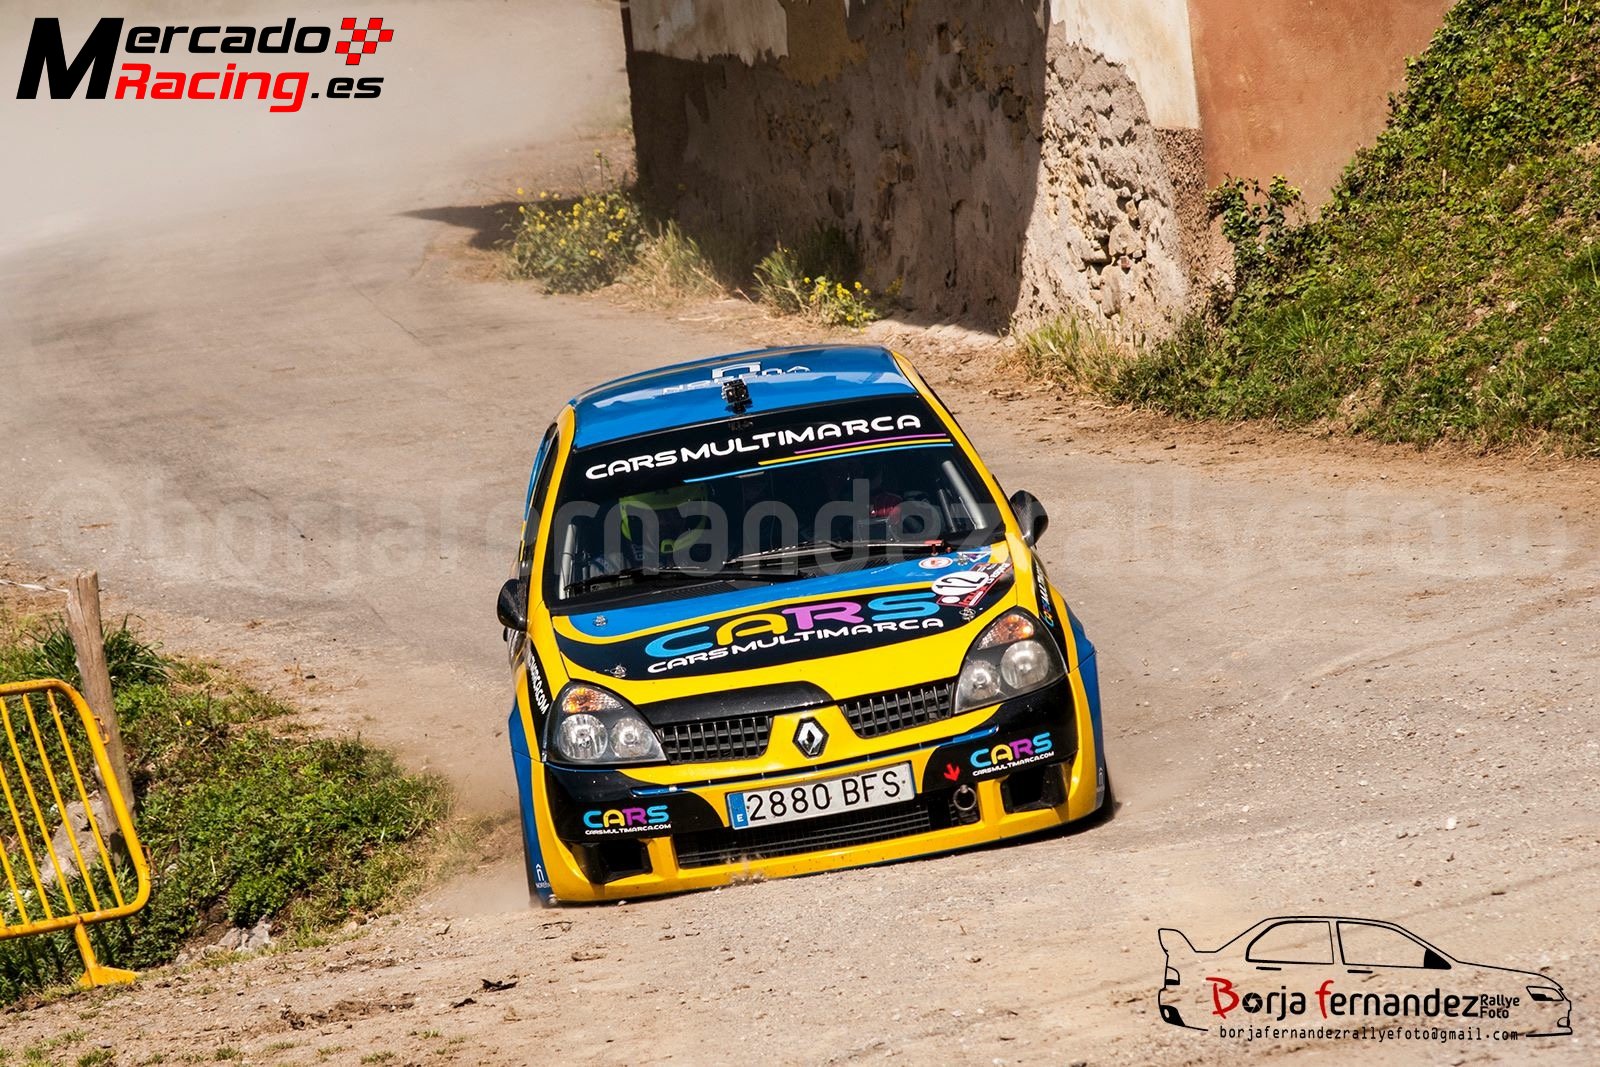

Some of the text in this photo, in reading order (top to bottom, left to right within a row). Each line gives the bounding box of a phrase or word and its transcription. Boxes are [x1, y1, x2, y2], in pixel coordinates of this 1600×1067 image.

[645, 592, 941, 658] CARS
[970, 732, 1053, 768] CARS
[583, 805, 669, 828] CARS
[736, 771, 900, 822] E 2880 BFS
